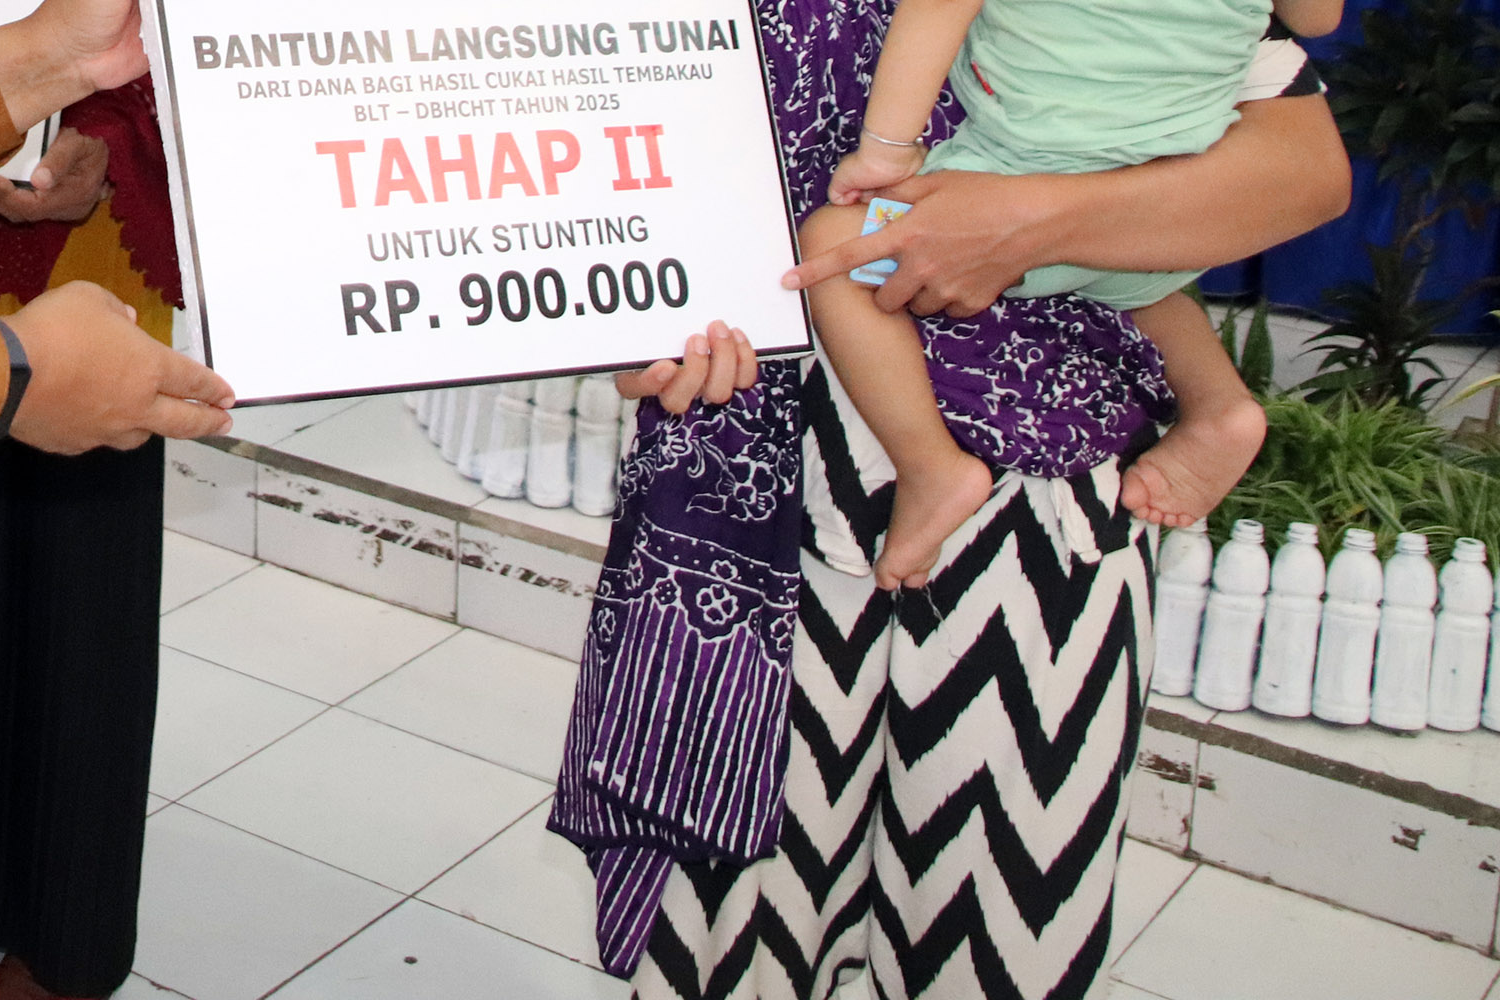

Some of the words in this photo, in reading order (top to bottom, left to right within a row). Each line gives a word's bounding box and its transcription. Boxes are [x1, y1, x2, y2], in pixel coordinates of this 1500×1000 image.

[192, 29, 394, 70] BANTUAN
[405, 22, 620, 63] LANGSUNG
[628, 19, 740, 54] TUNAI
[237, 80, 292, 99] DARI
[298, 77, 357, 97] DANA
[362, 75, 414, 95] BAGI
[419, 72, 480, 92] HASIL
[485, 70, 547, 90] CUKAI
[552, 67, 610, 87] HASIL
[613, 63, 714, 84] TEMBAKAU
[354, 104, 390, 122] BLT
[415, 99, 496, 120] DBHCHT
[501, 95, 570, 116] TAHUN
[575, 93, 621, 112] 2025
[315, 129, 582, 209] TAHAP
[603, 124, 674, 192] II
[367, 226, 484, 262] UNTUK
[491, 215, 649, 253] STUNTING
[340, 279, 441, 336] RP.
[458, 257, 690, 327] 900.000
